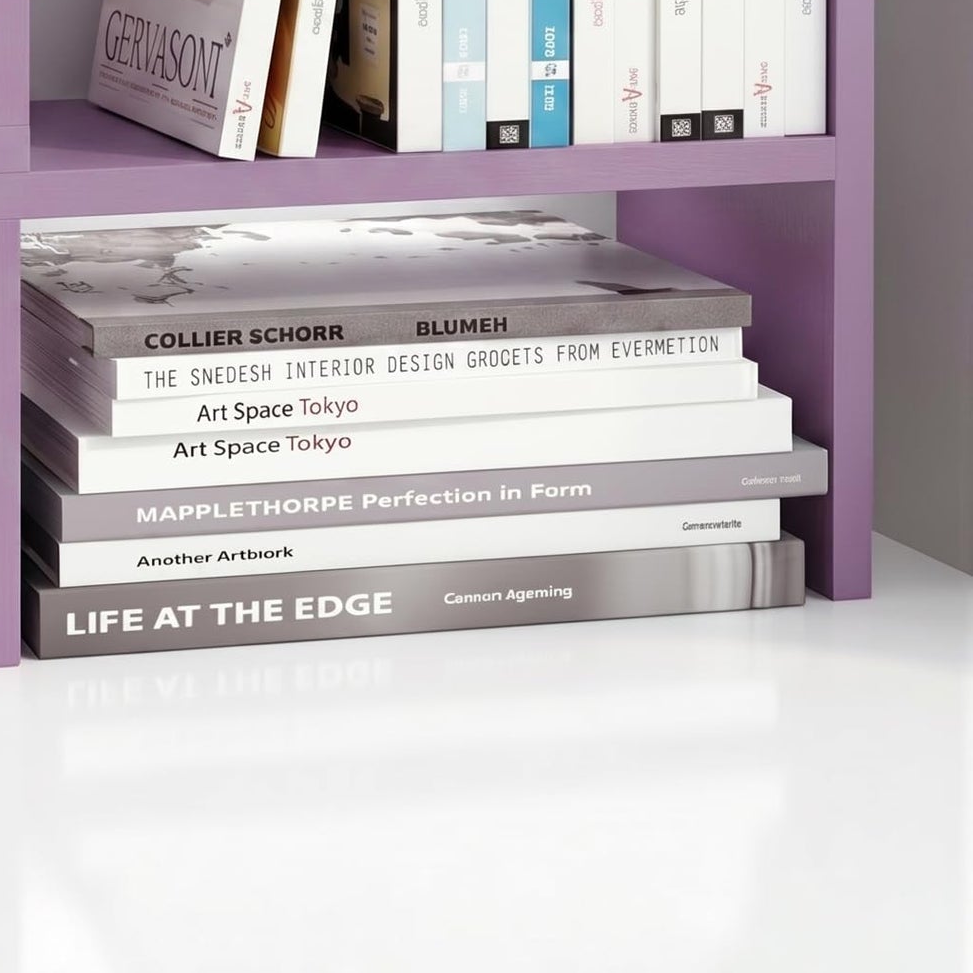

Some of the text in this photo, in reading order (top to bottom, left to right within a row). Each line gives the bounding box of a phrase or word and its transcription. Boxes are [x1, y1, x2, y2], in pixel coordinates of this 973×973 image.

[144, 324, 345, 350] COLLIER SCHORR
[415, 316, 509, 339] BLUMEH
[144, 335, 720, 389] THE SNEDESH INTERIOR DESIGN GROCETS FROM EVERMETION
[196, 396, 359, 424] Art Space Tokyo
[173, 434, 352, 459] Art Space Tokyo
[136, 482, 592, 524] MAPPLETHORPE Perfection in Form
[137, 552, 213, 568] Another
[505, 585, 573, 603] Ageming
[66, 591, 392, 636] LIFE AT THE EDGE
